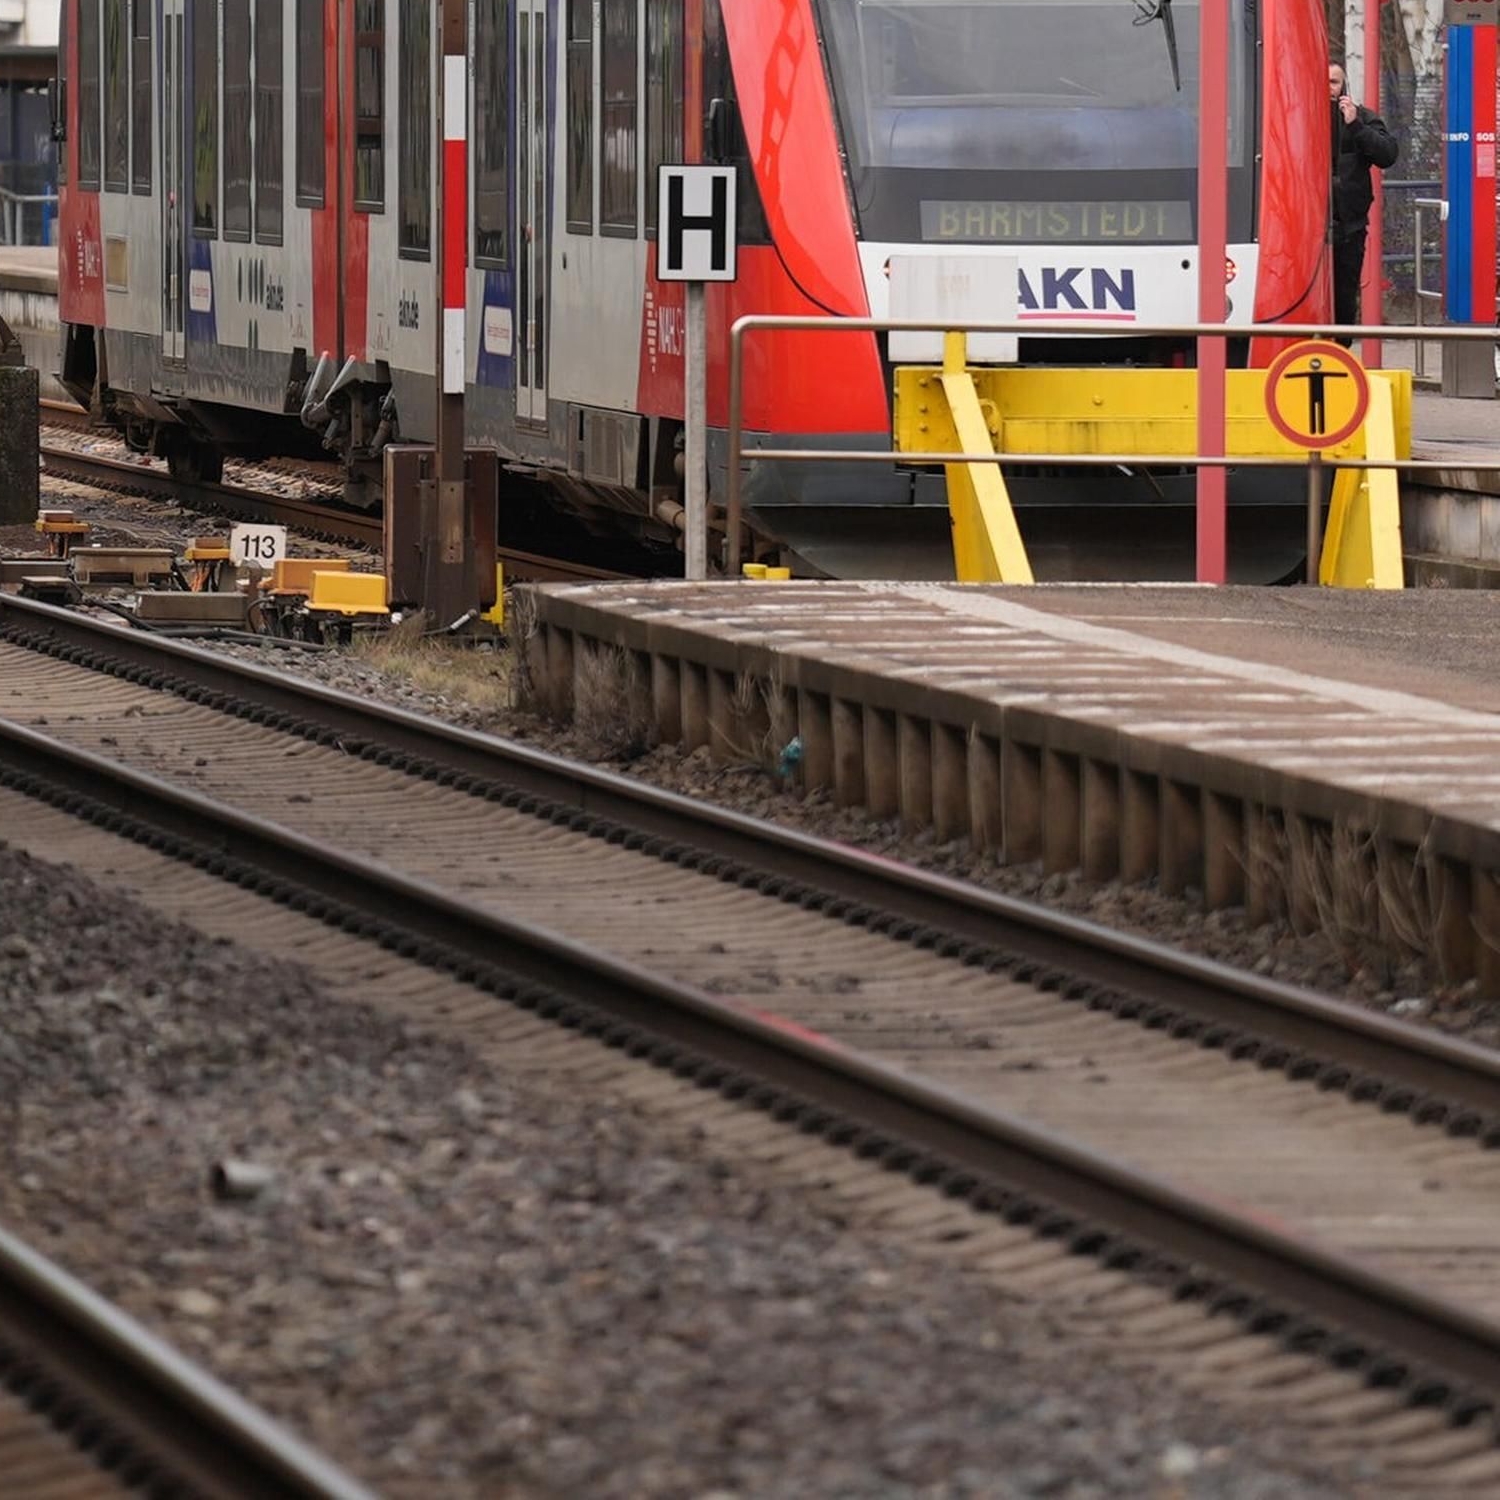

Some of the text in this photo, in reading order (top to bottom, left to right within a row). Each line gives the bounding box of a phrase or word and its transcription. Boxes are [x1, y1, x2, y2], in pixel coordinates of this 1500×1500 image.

[667, 175, 727, 271] H
[939, 202, 1167, 237] BARMSTEDT
[241, 534, 276, 559] 113
